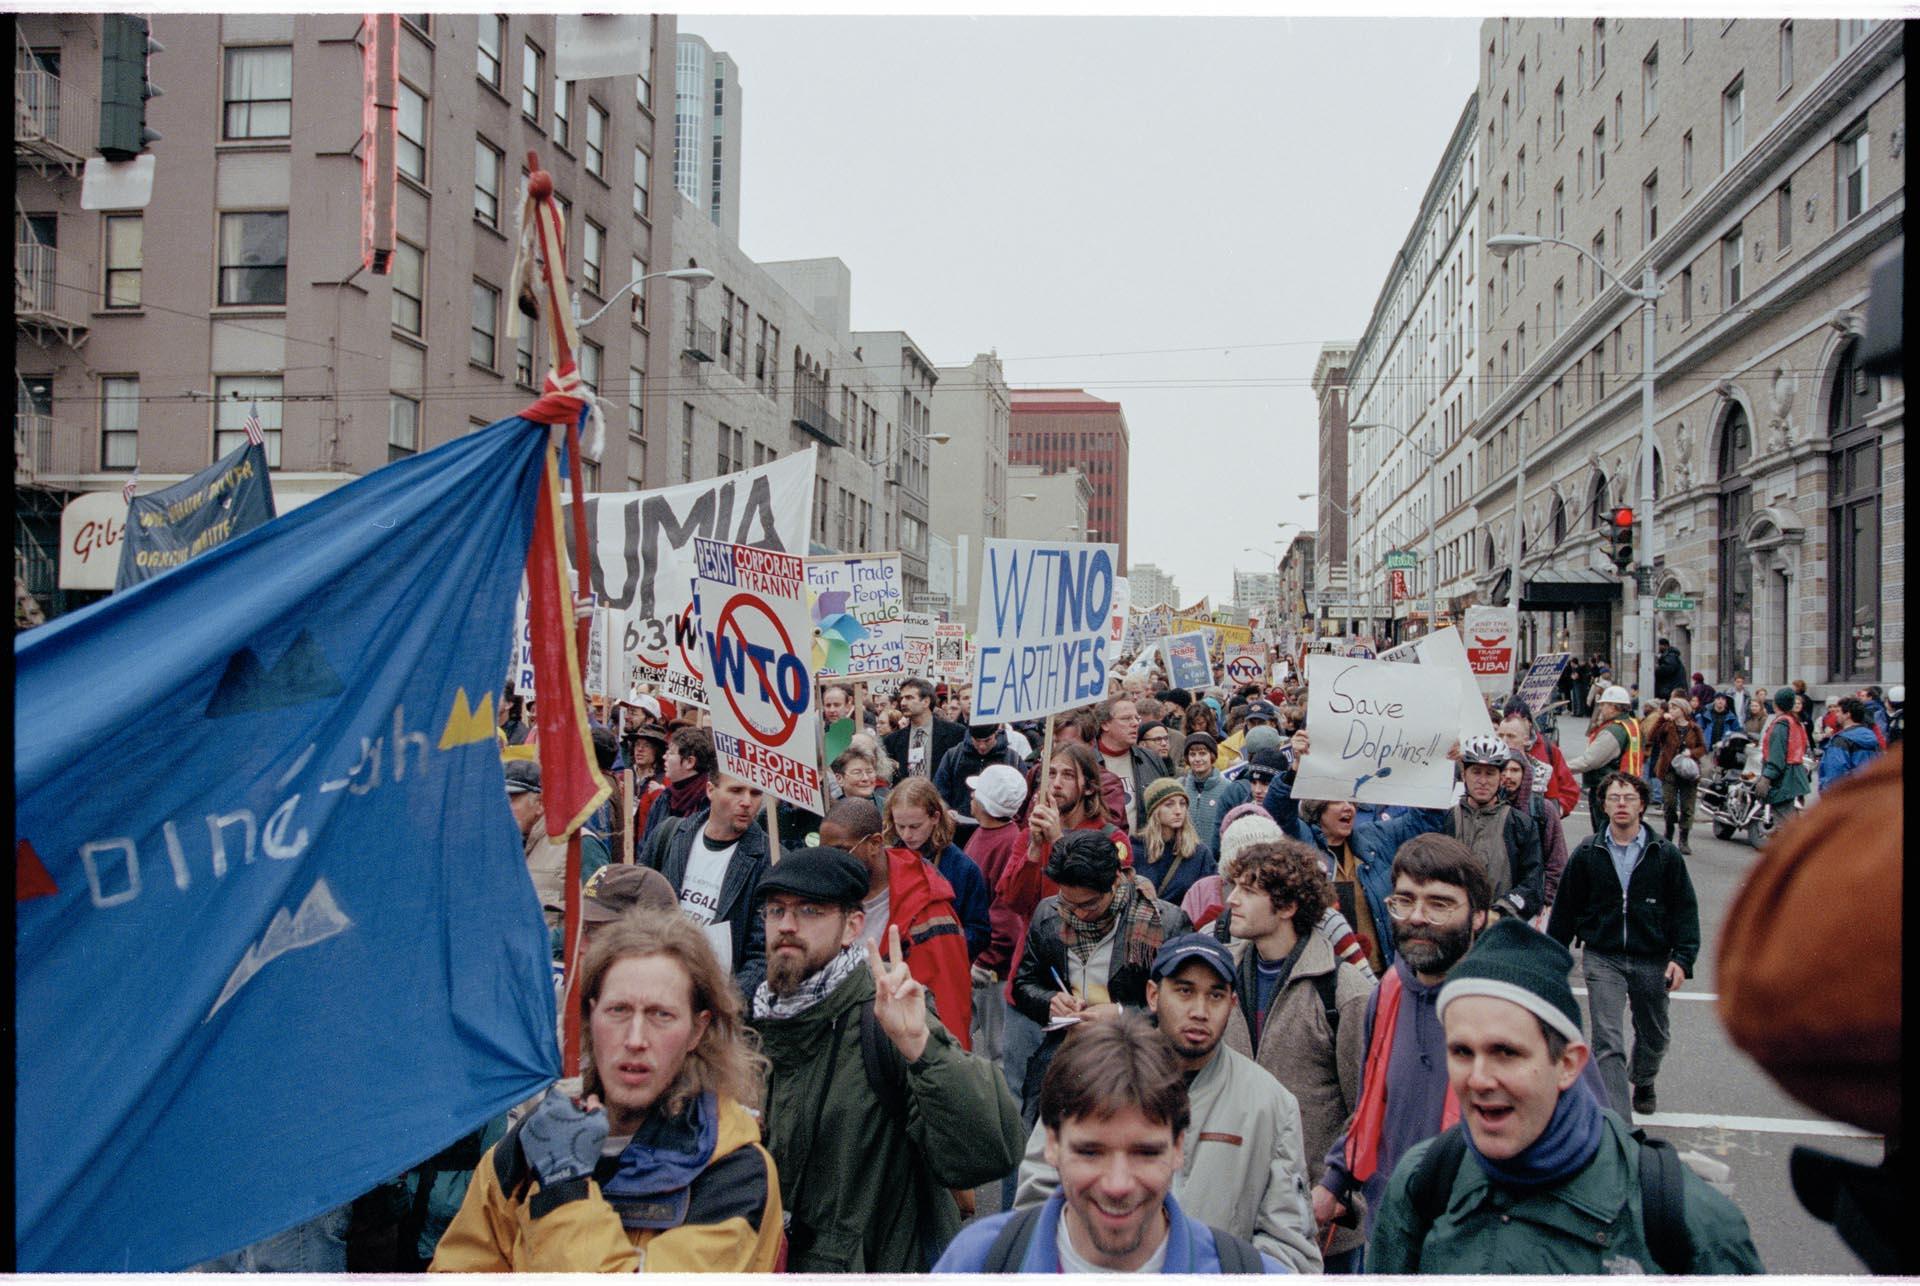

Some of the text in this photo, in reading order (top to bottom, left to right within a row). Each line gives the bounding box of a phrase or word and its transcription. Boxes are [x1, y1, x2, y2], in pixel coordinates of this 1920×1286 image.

[696, 539, 801, 584] RESIST CORPORATE
[807, 558, 894, 585] Fair Trade
[738, 569, 799, 600] TYRANNY
[853, 581, 900, 607] People
[1656, 600, 1683, 609] Stewart
[903, 614, 929, 626] Venice
[882, 632, 904, 650] and
[1381, 649, 1407, 662] TELL
[1470, 661, 1509, 671] CUBA!
[670, 671, 687, 684] WE
[705, 631, 810, 715] WTO
[1226, 664, 1262, 677] WTO
[667, 682, 700, 701] PUBLIC
[1329, 665, 1404, 718] Save
[1342, 719, 1442, 768] Dolphins!!
[716, 733, 815, 787] THE PEOPLE
[726, 757, 814, 807] HAVE SPOKEN!
